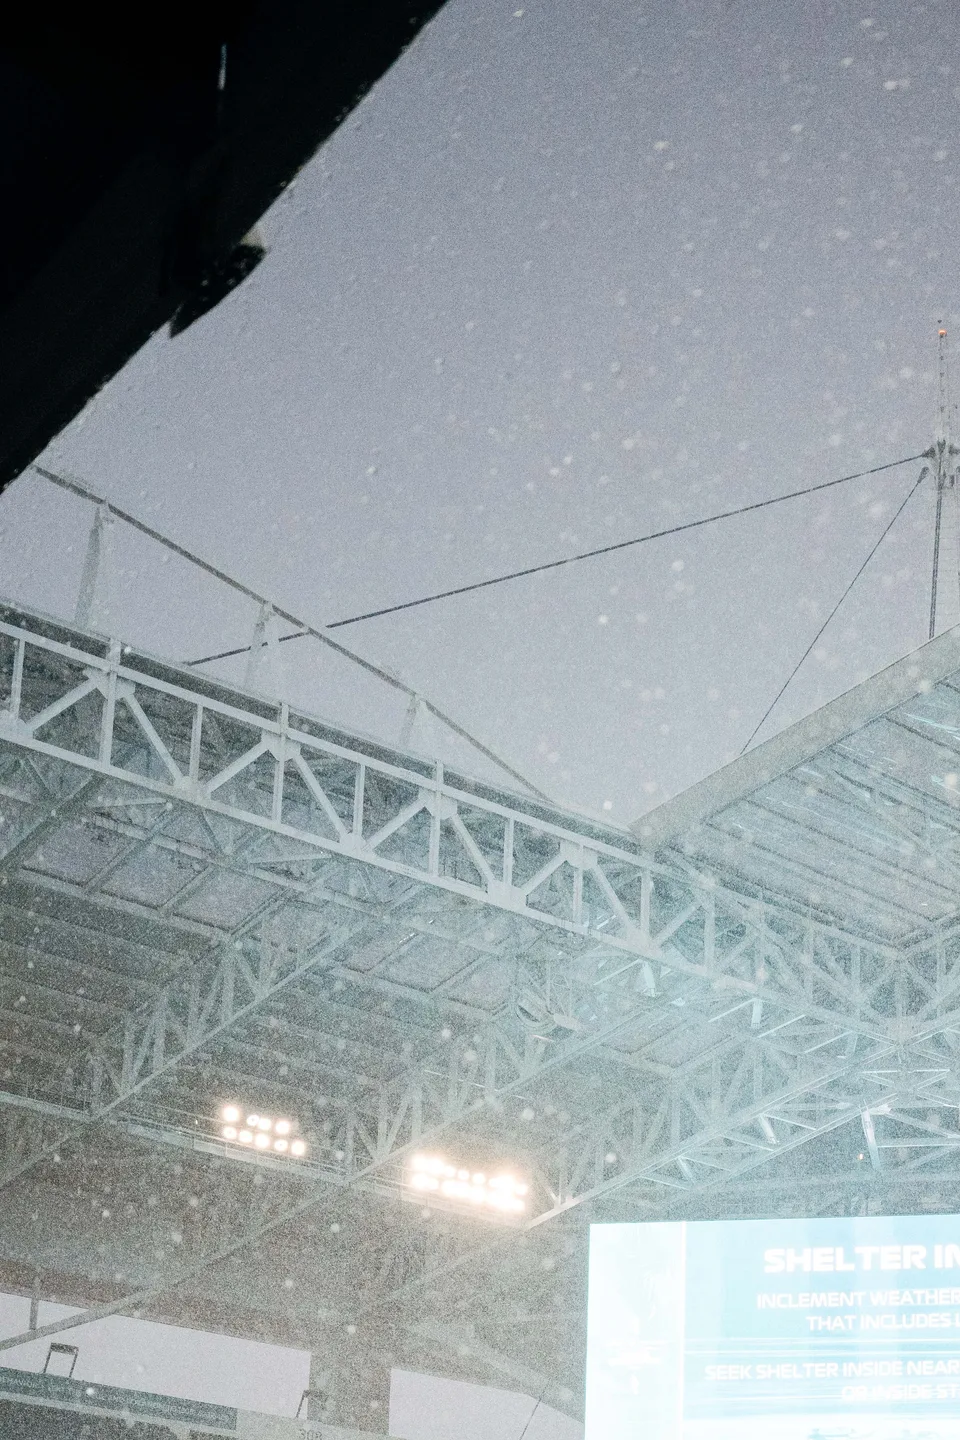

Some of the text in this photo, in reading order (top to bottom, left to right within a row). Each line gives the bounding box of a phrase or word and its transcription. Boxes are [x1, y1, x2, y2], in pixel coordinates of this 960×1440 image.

[764, 1244, 926, 1273] SHELTER
[756, 1291, 867, 1310] INCLEMENT
[806, 1313, 857, 1332] THAT
[860, 1311, 951, 1331] INCLUDES
[704, 1364, 752, 1381] SEEK
[755, 1362, 839, 1380] SHELTER
[842, 1358, 904, 1378] INSIDE
[871, 1383, 932, 1401] INSIDE
